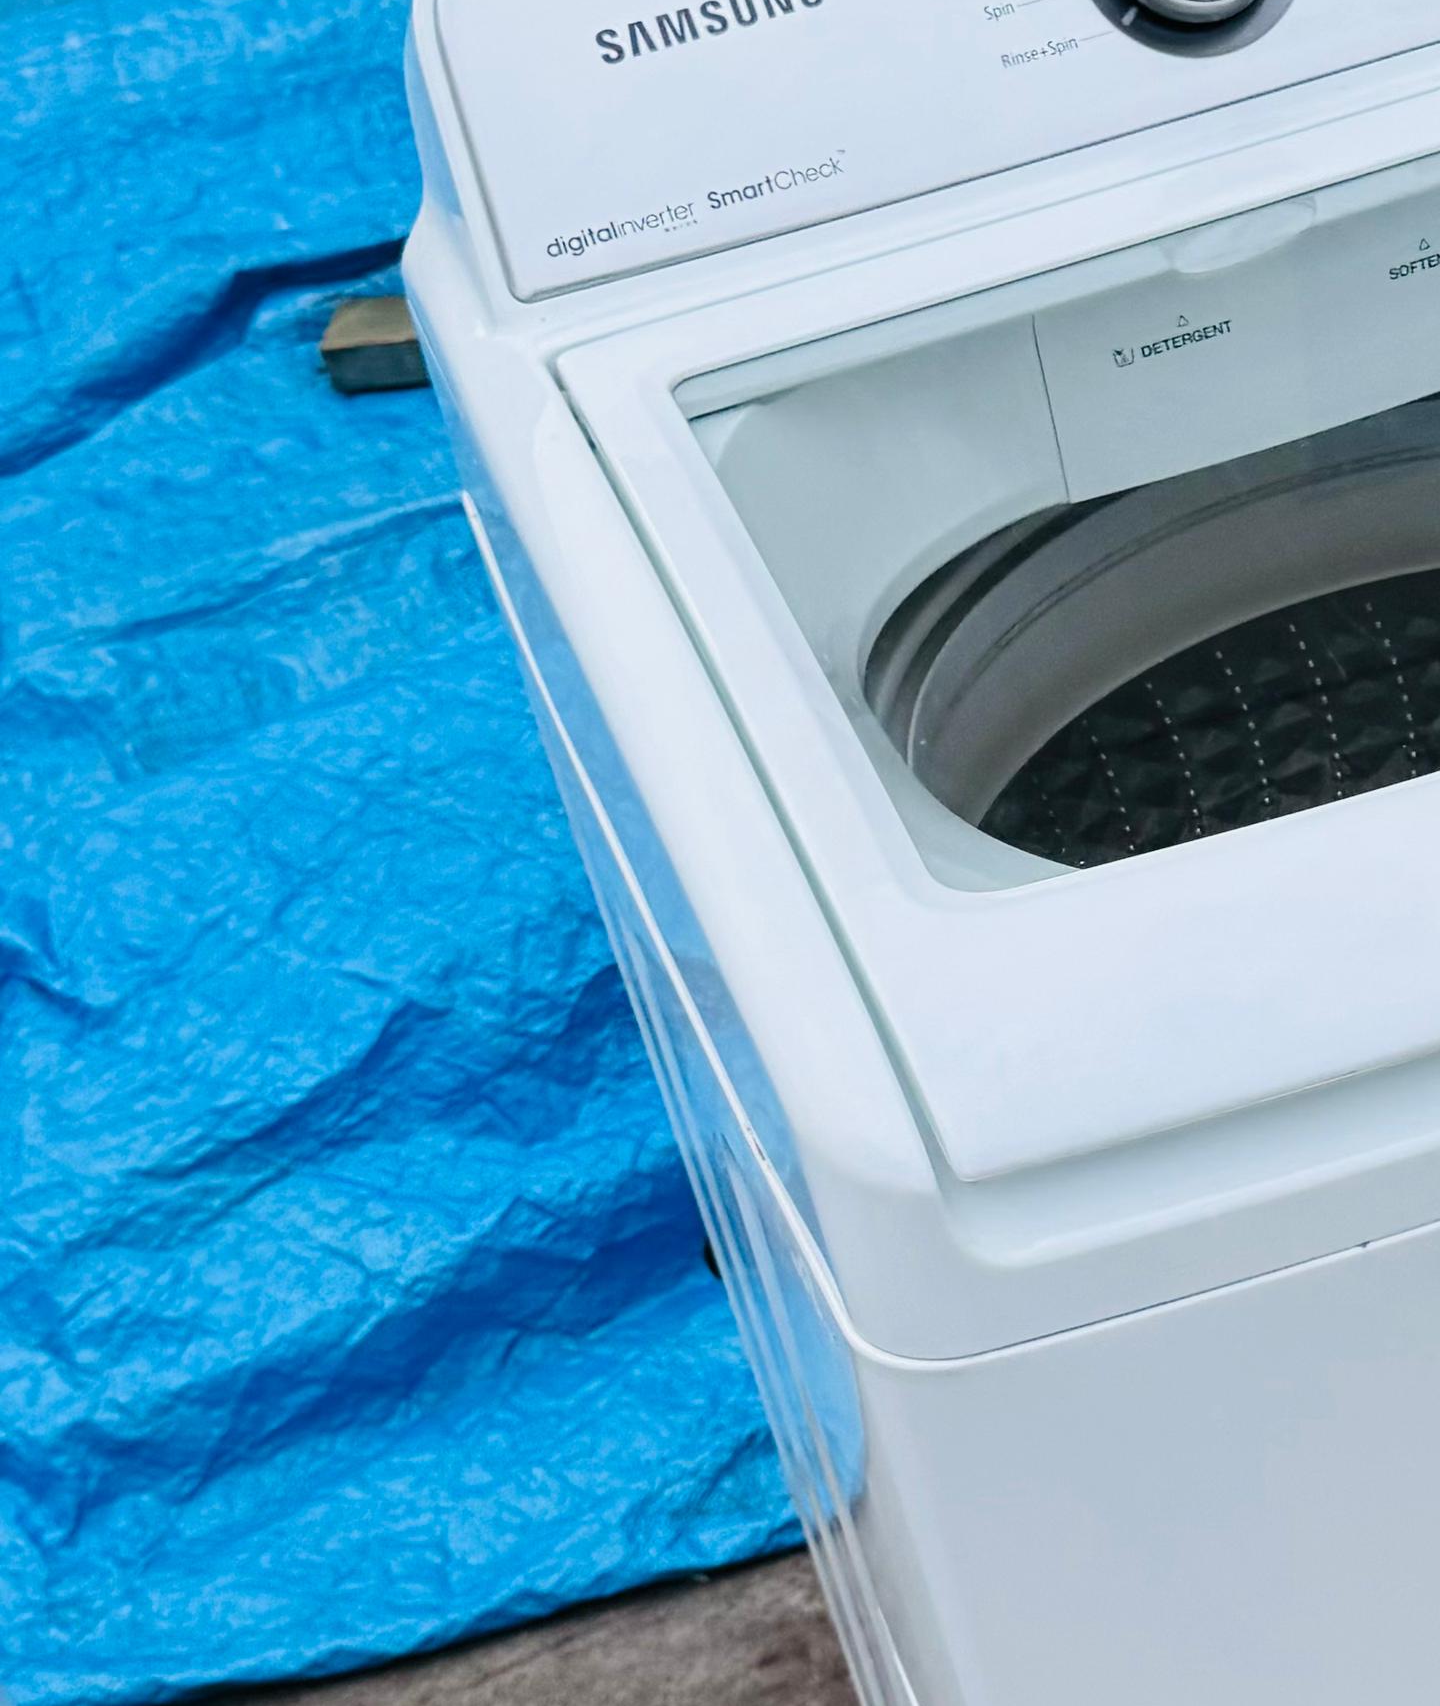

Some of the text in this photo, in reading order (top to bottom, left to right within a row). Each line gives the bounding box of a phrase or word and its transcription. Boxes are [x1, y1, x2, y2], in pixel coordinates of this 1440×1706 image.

[984, 2, 1015, 21] Spin
[1000, 37, 1078, 69] Rinse+Spin
[1140, 319, 1233, 359] DETERGENT
